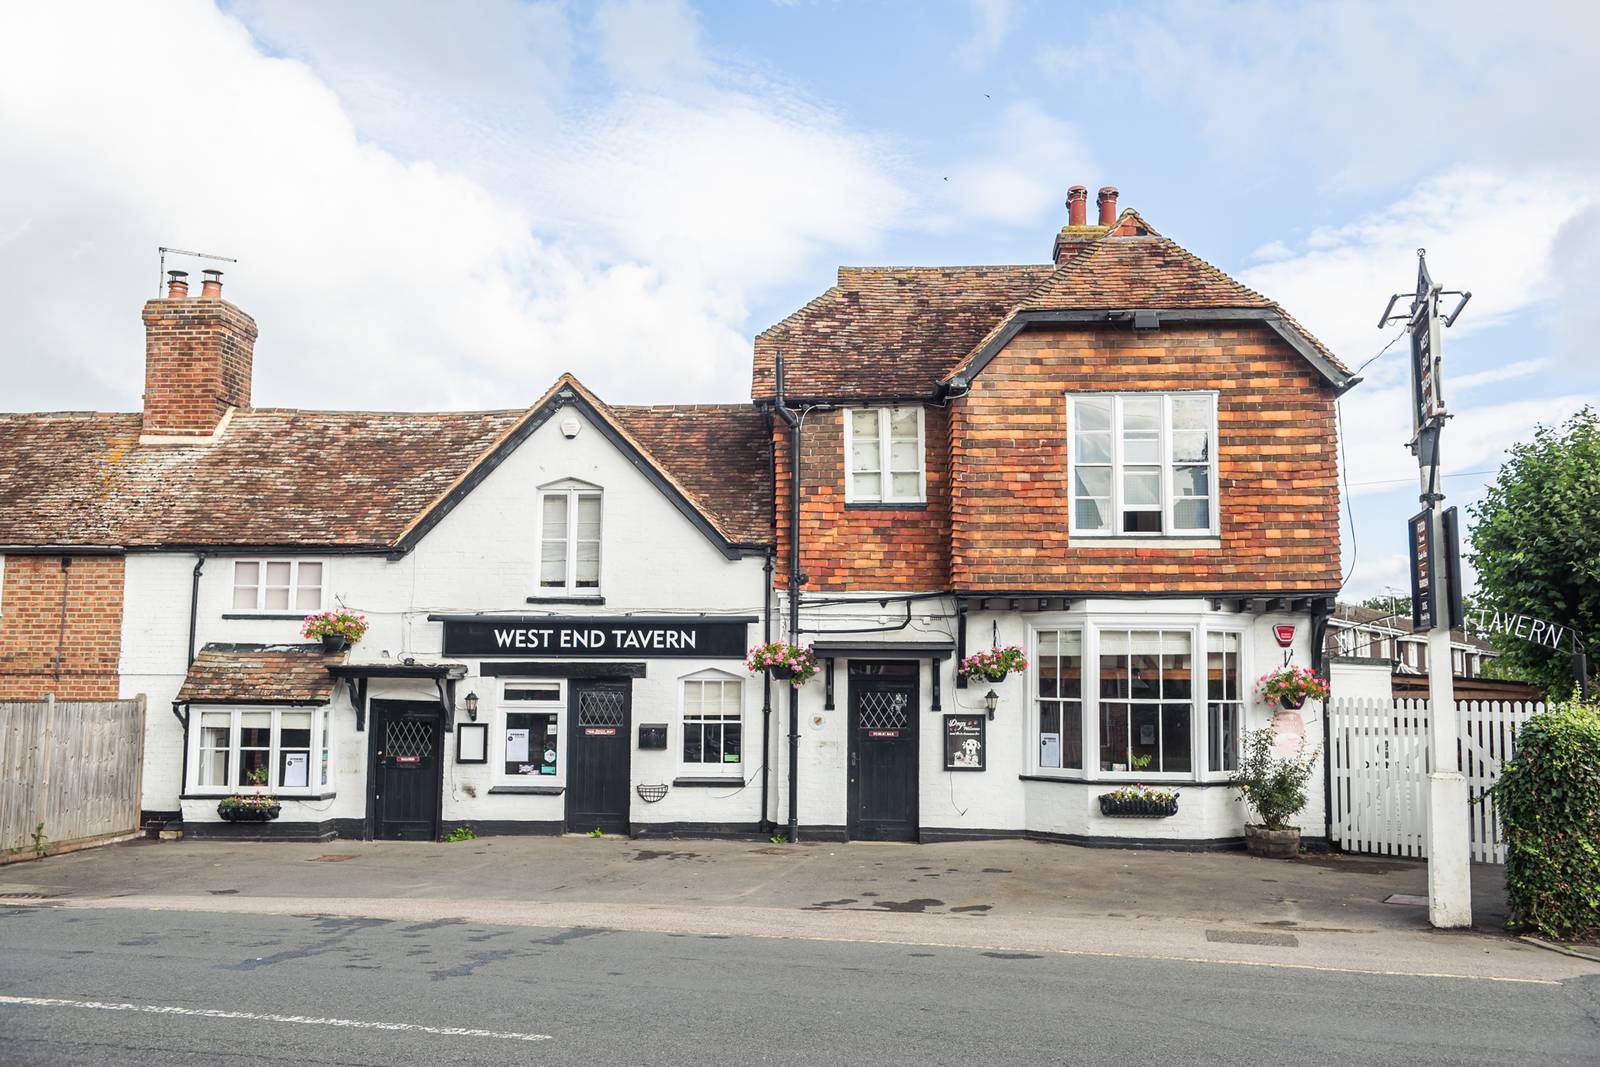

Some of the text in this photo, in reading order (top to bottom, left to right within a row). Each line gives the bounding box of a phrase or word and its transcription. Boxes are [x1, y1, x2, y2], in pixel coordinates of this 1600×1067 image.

[494, 629, 696, 648] WEST END TAVERN
[1475, 609, 1563, 648] TAVERN
